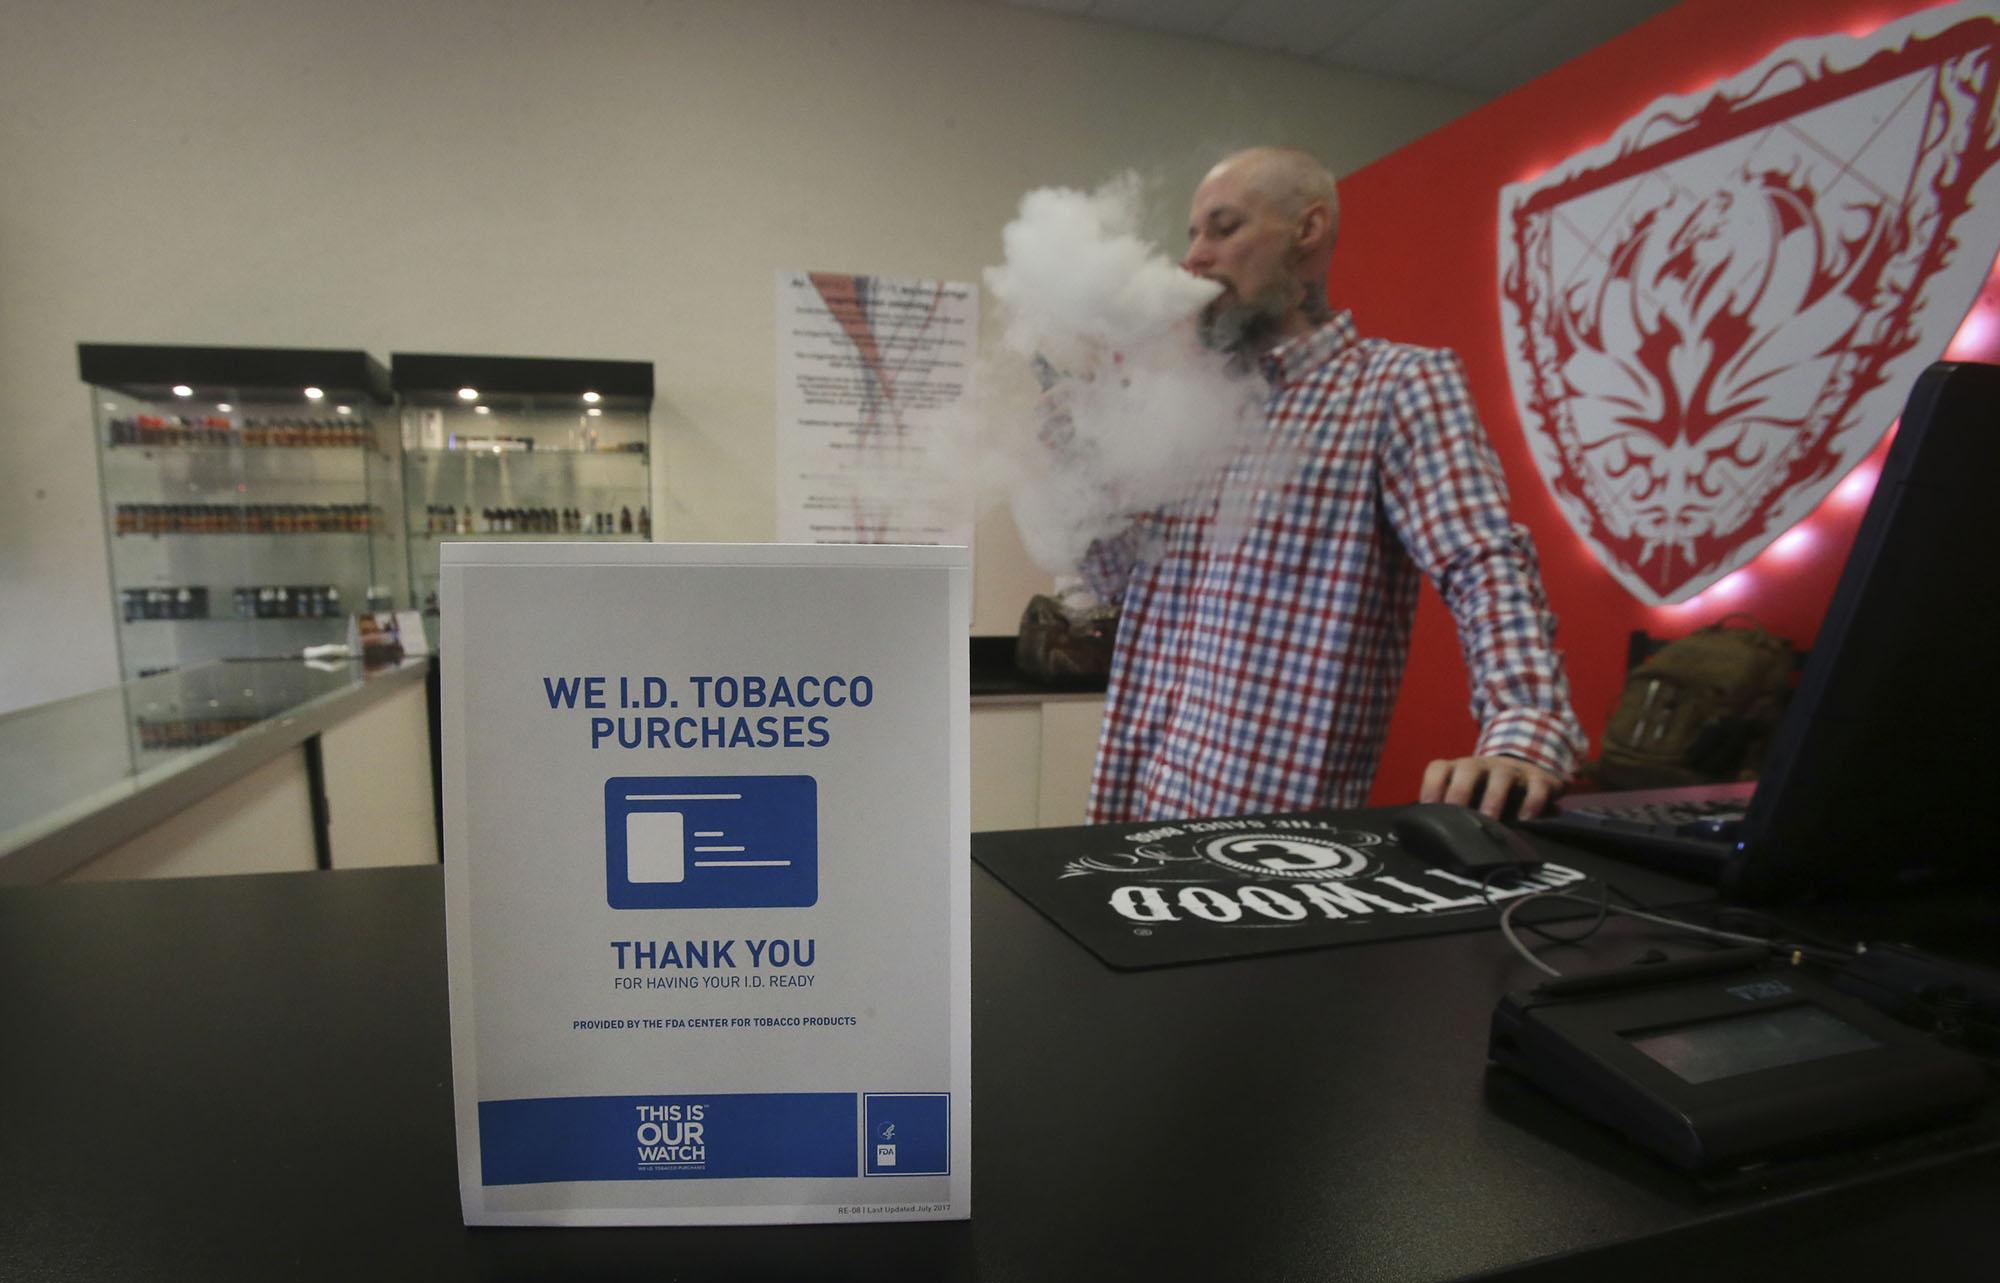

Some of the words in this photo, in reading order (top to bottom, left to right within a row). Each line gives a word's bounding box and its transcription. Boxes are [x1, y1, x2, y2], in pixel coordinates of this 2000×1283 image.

[543, 676, 607, 709] WE
[619, 676, 679, 709] I.D.
[690, 675, 874, 708] TOBACCO
[591, 716, 830, 749] PURCHASES
[1109, 862, 1587, 924] TTWOOD
[610, 940, 736, 970] THANK
[745, 939, 816, 968] YOU
[614, 977, 642, 990] FOR
[646, 976, 699, 989] HAVING
[702, 976, 740, 988] YOUR
[744, 976, 766, 988] I.D.
[769, 975, 815, 988] READY
[573, 1020, 624, 1029] PROVIDED
[627, 1020, 640, 1029] BY
[643, 1020, 663, 1029] THE
[665, 1019, 685, 1028] FDA
[688, 1018, 728, 1028] CENTER
[731, 1018, 751, 1027] FOR
[754, 1018, 801, 1027] TOBACCO
[803, 1016, 857, 1026] PRODUCTS
[636, 1105, 682, 1121] THIS
[686, 1104, 705, 1121] IS
[637, 1121, 705, 1146] OUR
[637, 1145, 706, 1161] WATCH
[867, 1206, 883, 1214] Last
[884, 1205, 915, 1214] Updated
[917, 1205, 932, 1213] July
[933, 1204, 951, 1212] 2017
